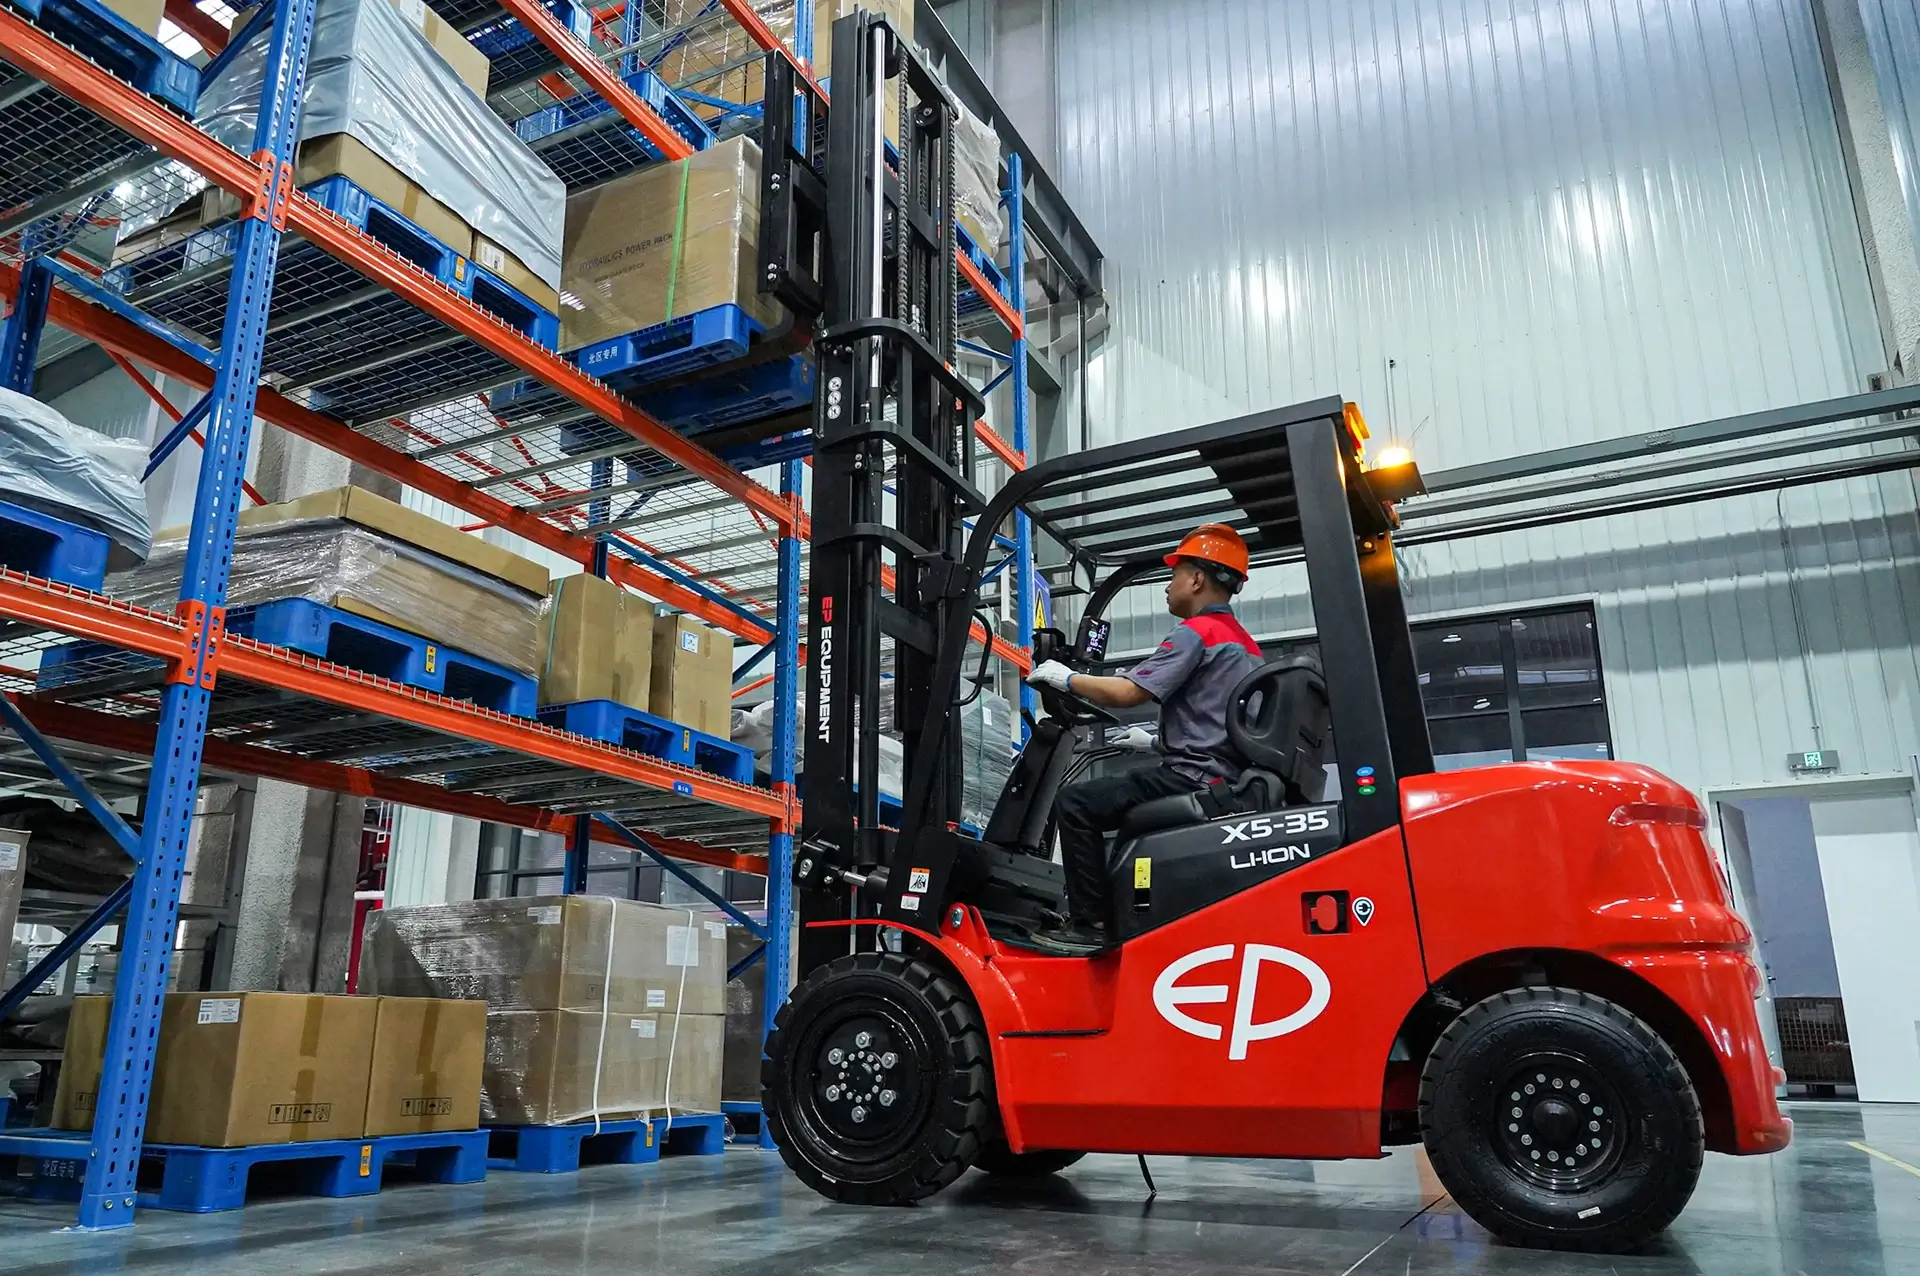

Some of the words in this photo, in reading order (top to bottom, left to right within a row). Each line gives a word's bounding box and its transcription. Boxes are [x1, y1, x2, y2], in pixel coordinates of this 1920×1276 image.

[625, 239, 651, 256] POWER
[653, 232, 673, 247] PACK
[588, 345, 618, 364] 北区专用
[818, 626, 832, 743] EQUIPMENT
[1220, 810, 1329, 844] X5-35
[1152, 943, 1331, 1061] EP
